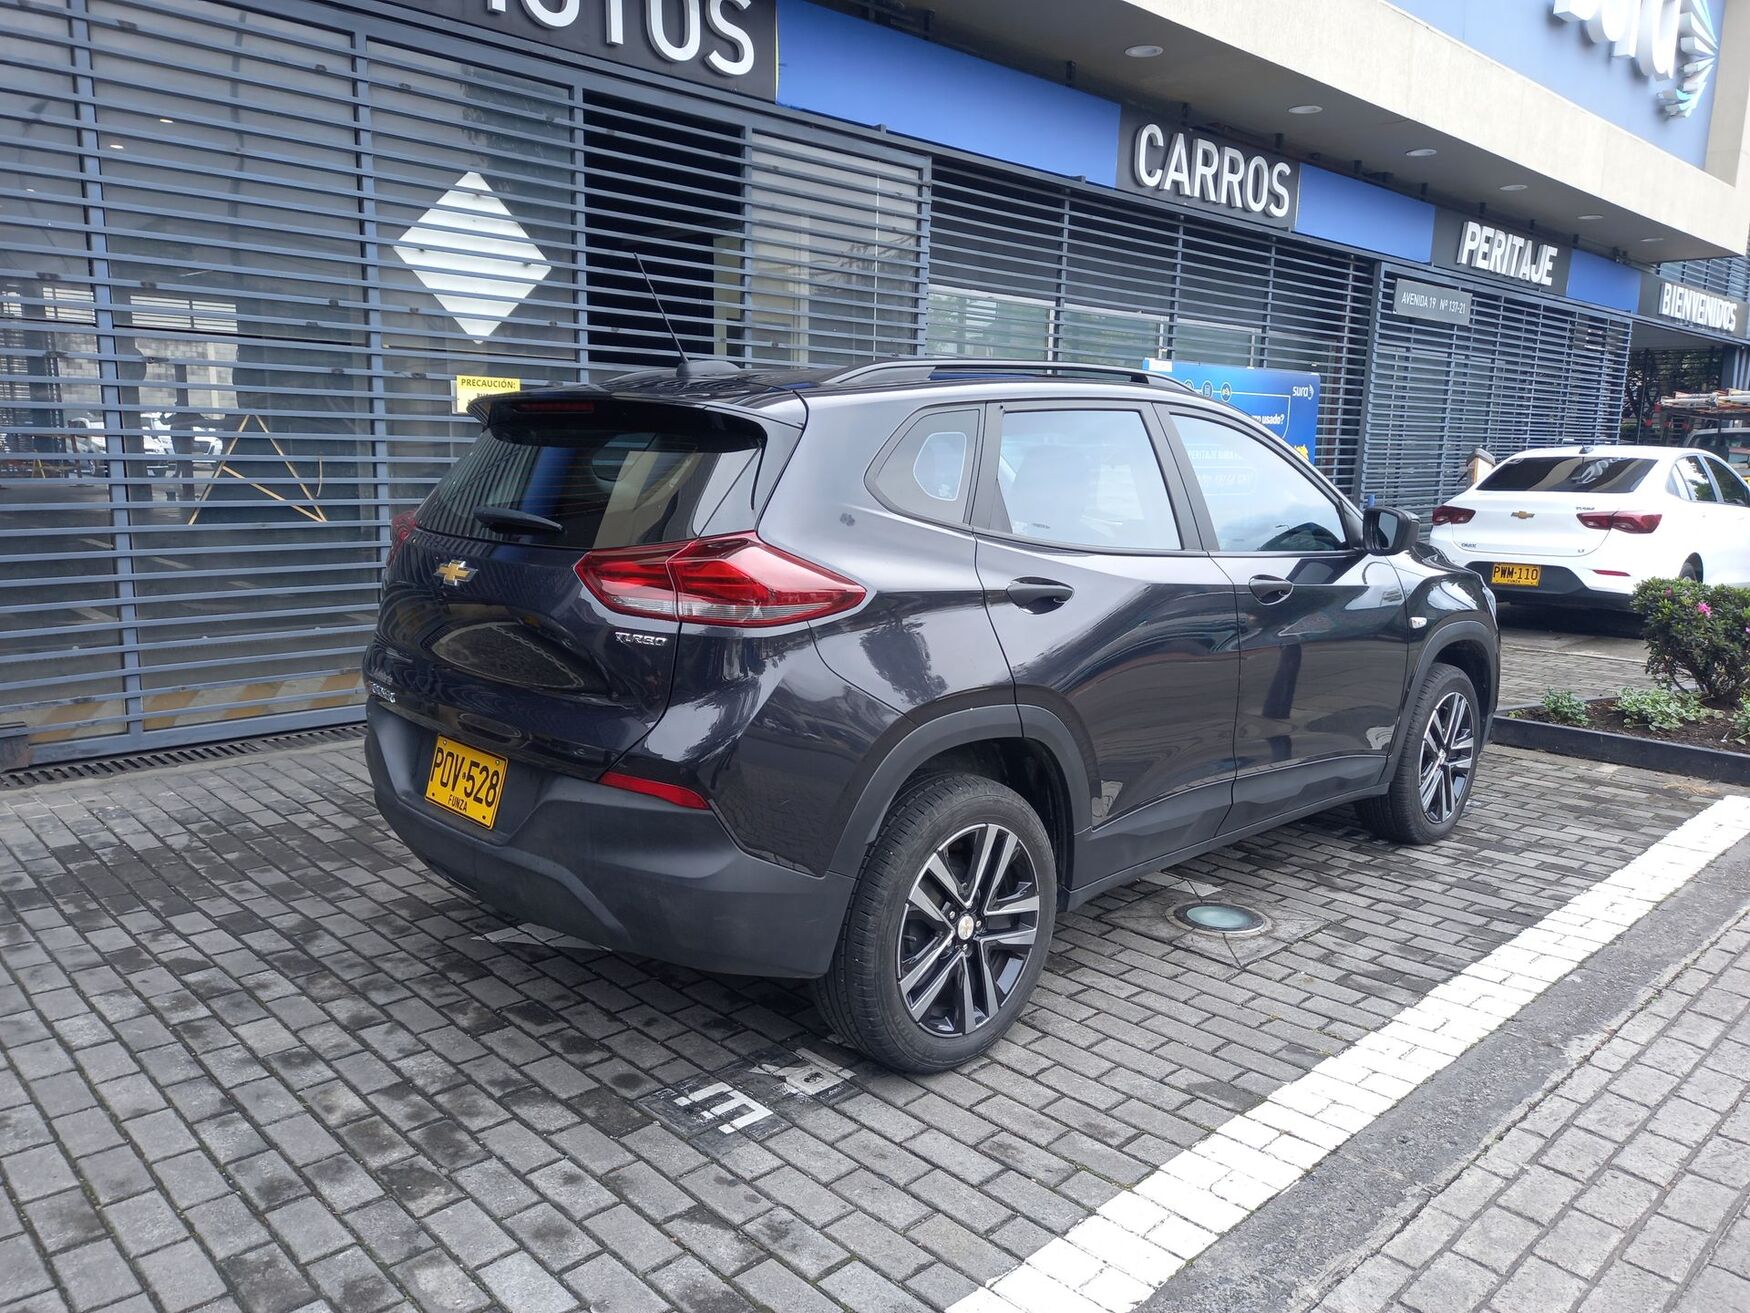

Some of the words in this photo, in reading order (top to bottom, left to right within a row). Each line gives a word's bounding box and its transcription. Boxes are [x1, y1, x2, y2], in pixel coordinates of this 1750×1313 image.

[1135, 124, 1291, 217] CARROS
[1458, 221, 1558, 286] PERITAJE
[1401, 291, 1428, 308] AVENIDA
[1429, 296, 1437, 309] 19
[1449, 300, 1466, 314] 137-21
[1660, 282, 1737, 332] BIENVENIDOS
[461, 378, 516, 389] PRECAUCIÓN:
[1292, 386, 1308, 397] sura
[448, 794, 468, 813] FUNZA
